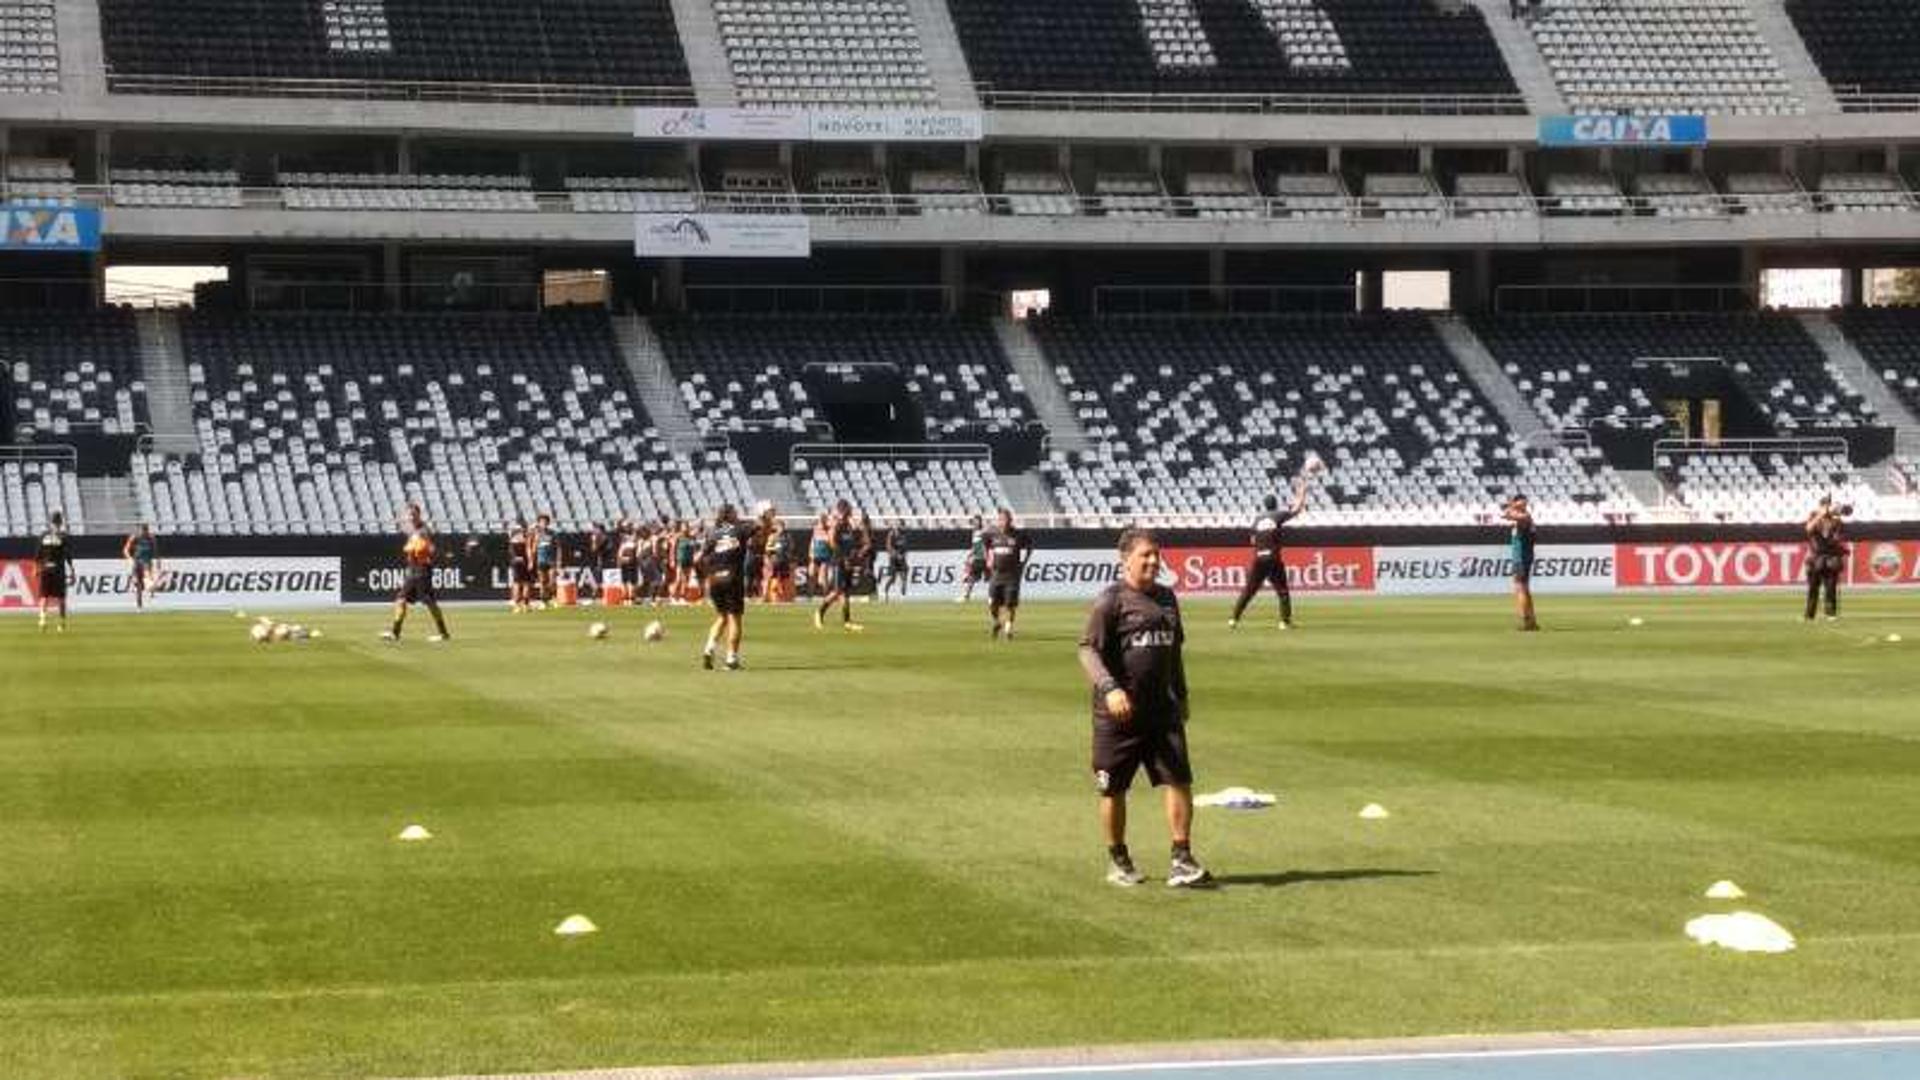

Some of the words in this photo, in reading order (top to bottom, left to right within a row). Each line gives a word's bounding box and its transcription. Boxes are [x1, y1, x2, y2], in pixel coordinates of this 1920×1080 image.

[1573, 116, 1671, 142] CAIXA
[1184, 551, 1360, 588] Sannder
[1377, 560, 1450, 578] PNEUS
[1459, 556, 1613, 578] BRIDESTONE
[153, 570, 338, 593] BRIDGESTONE
